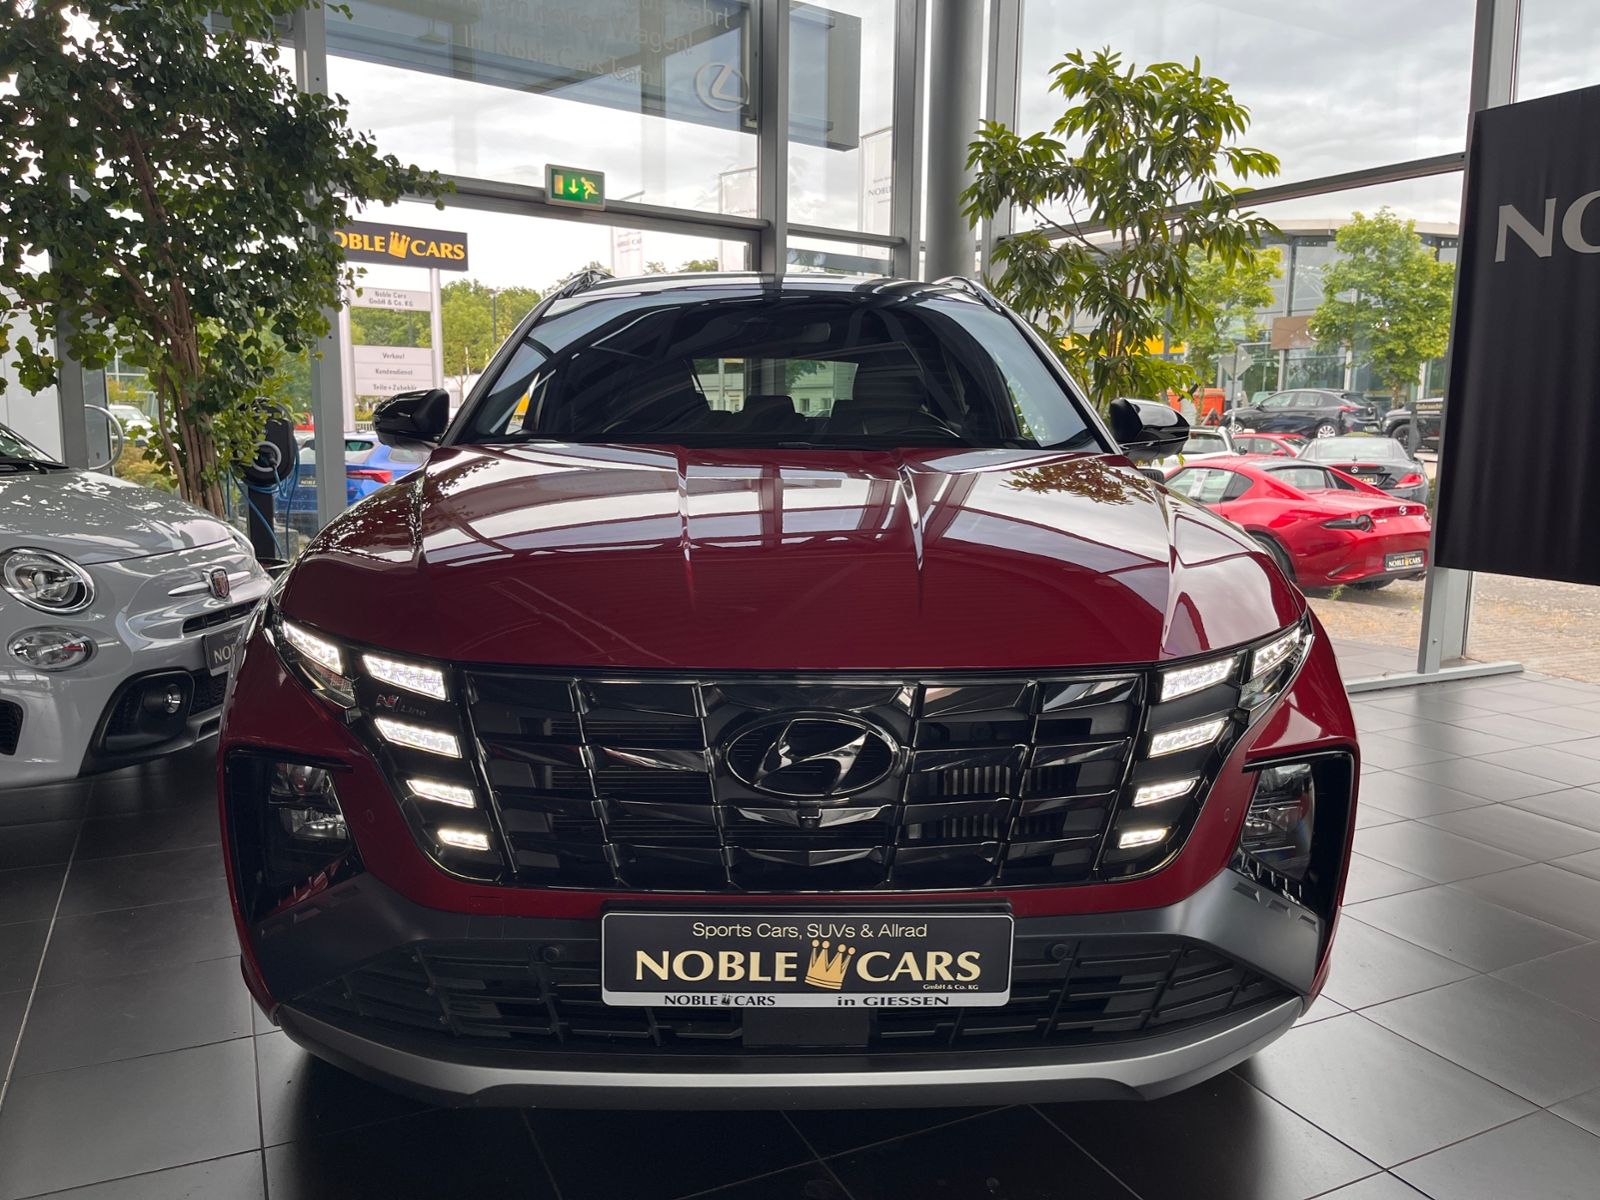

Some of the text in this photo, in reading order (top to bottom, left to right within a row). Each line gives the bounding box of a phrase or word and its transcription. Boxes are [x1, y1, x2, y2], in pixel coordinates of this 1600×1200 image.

[410, 240, 466, 260] CARS
[1388, 558, 1405, 568] NOBLE
[1408, 556, 1422, 565] CARS
[692, 922, 928, 939] Sports Cars, SUVs & Allrad
[635, 950, 981, 982] NOBLE CARS
[664, 995, 949, 1006] NOBLE CARS in GIESSEN
